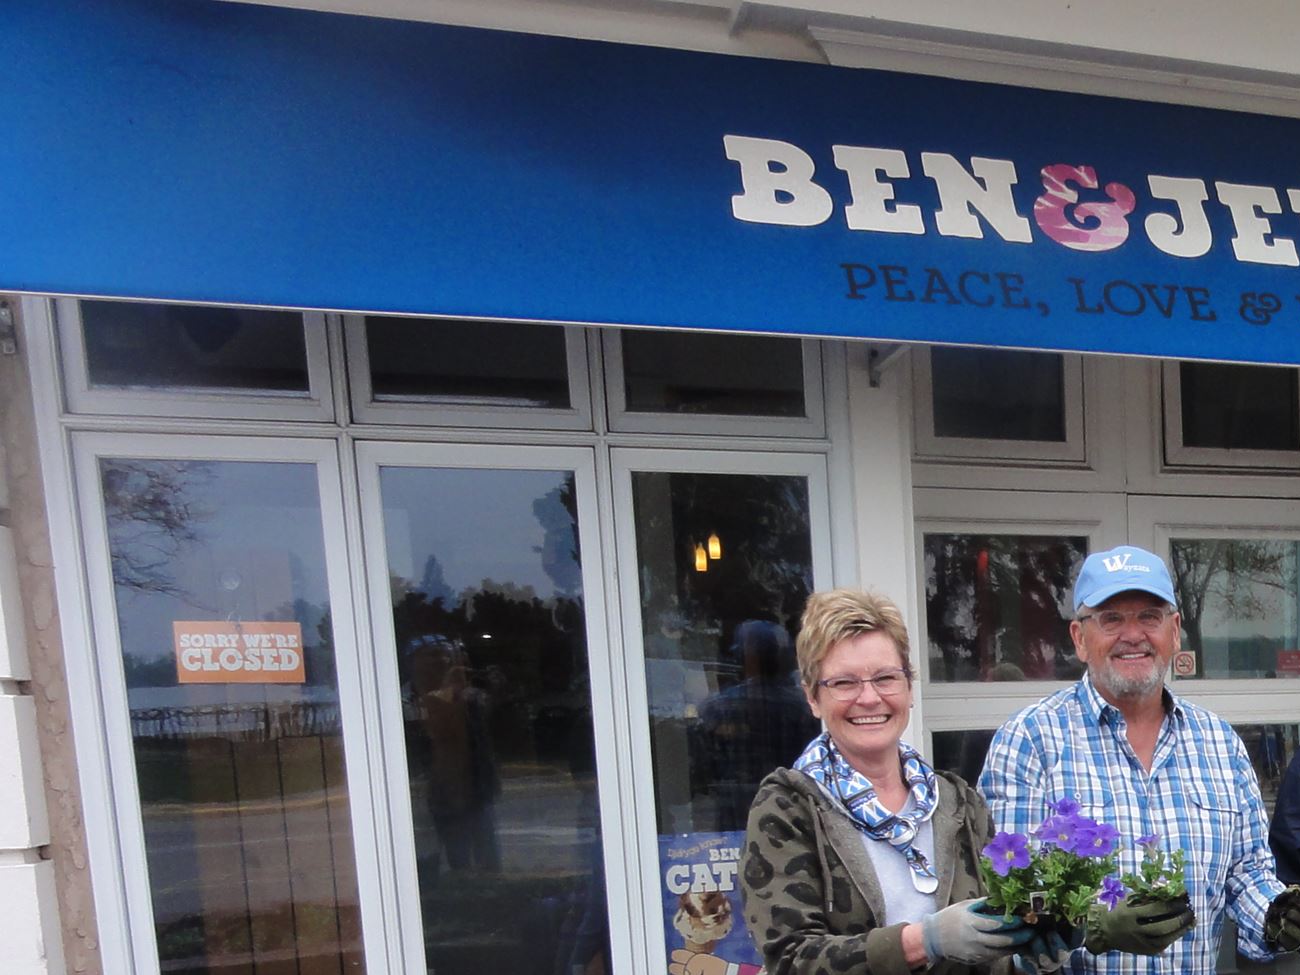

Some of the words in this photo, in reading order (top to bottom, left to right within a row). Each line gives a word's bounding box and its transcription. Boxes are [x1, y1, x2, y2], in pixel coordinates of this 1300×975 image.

[839, 262, 1050, 317] PEACE,
[1074, 280, 1212, 322] LOVE
[1239, 291, 1281, 325] &
[180, 634, 240, 648] SORRY
[242, 633, 298, 648] WE'RE
[181, 648, 299, 671] CLOSED
[709, 848, 740, 861] BEN
[666, 862, 738, 895] CAT
